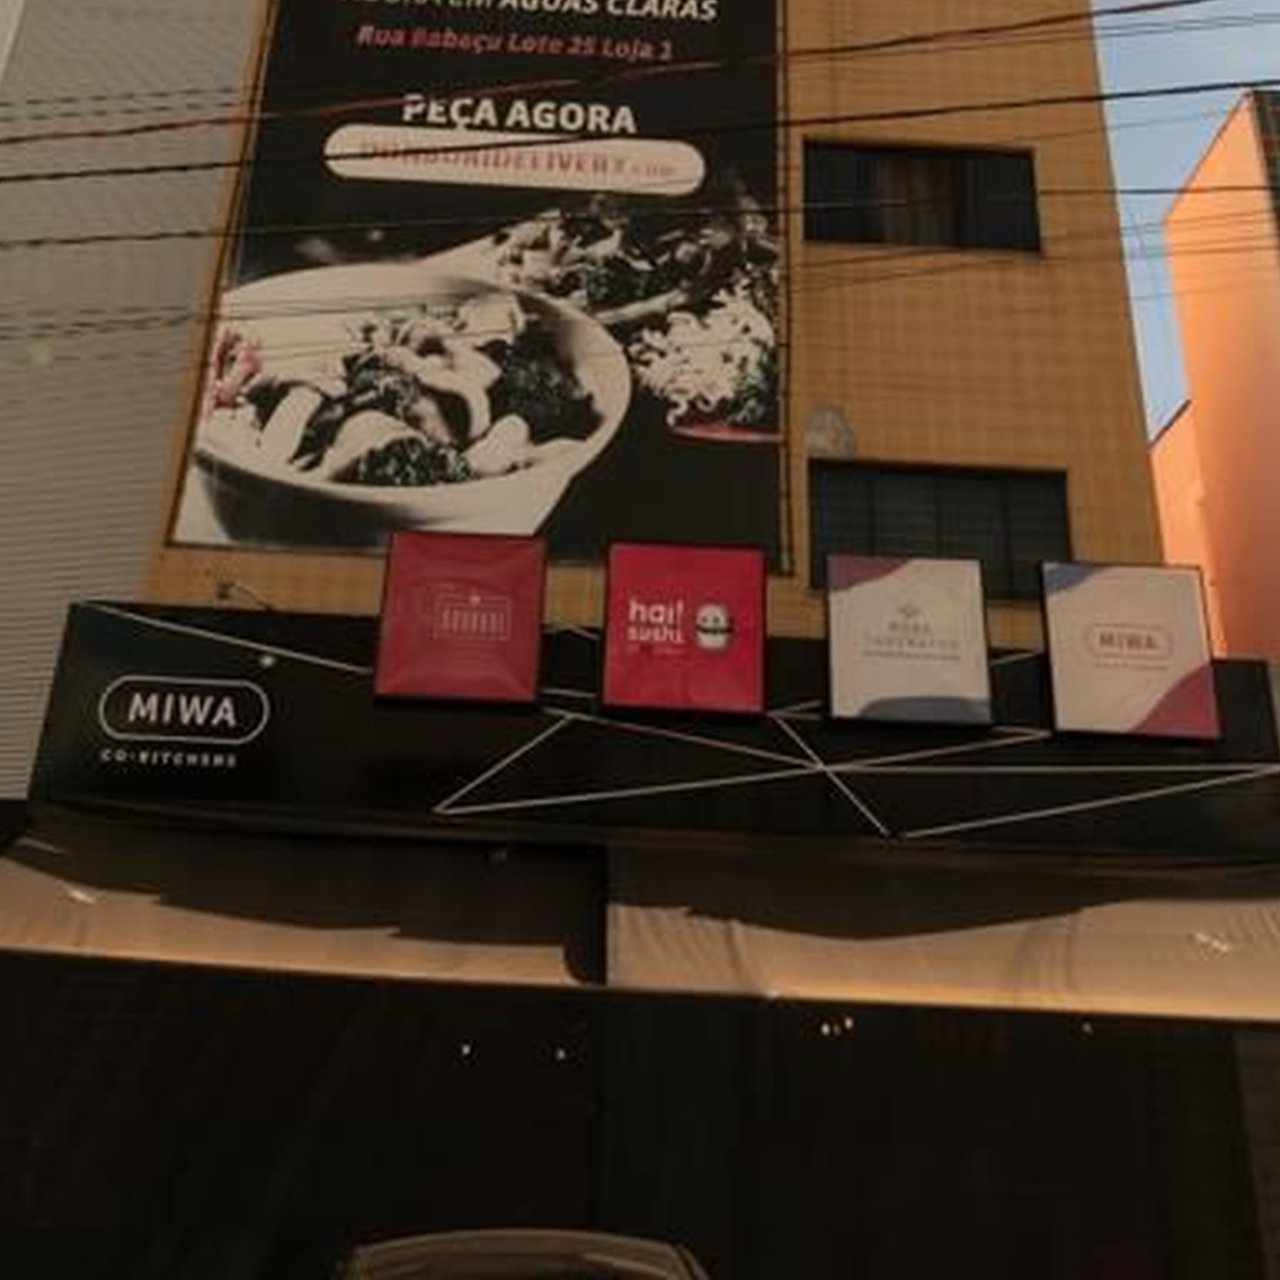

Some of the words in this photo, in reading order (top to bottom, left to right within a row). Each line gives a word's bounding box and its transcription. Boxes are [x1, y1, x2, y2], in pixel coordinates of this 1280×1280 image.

[356, 25, 405, 46] Rua
[508, 32, 563, 54] Lote
[600, 37, 655, 63] Loja
[402, 94, 498, 131] PEÇA
[506, 101, 638, 134] AGORA
[128, 692, 237, 727] MIWA
